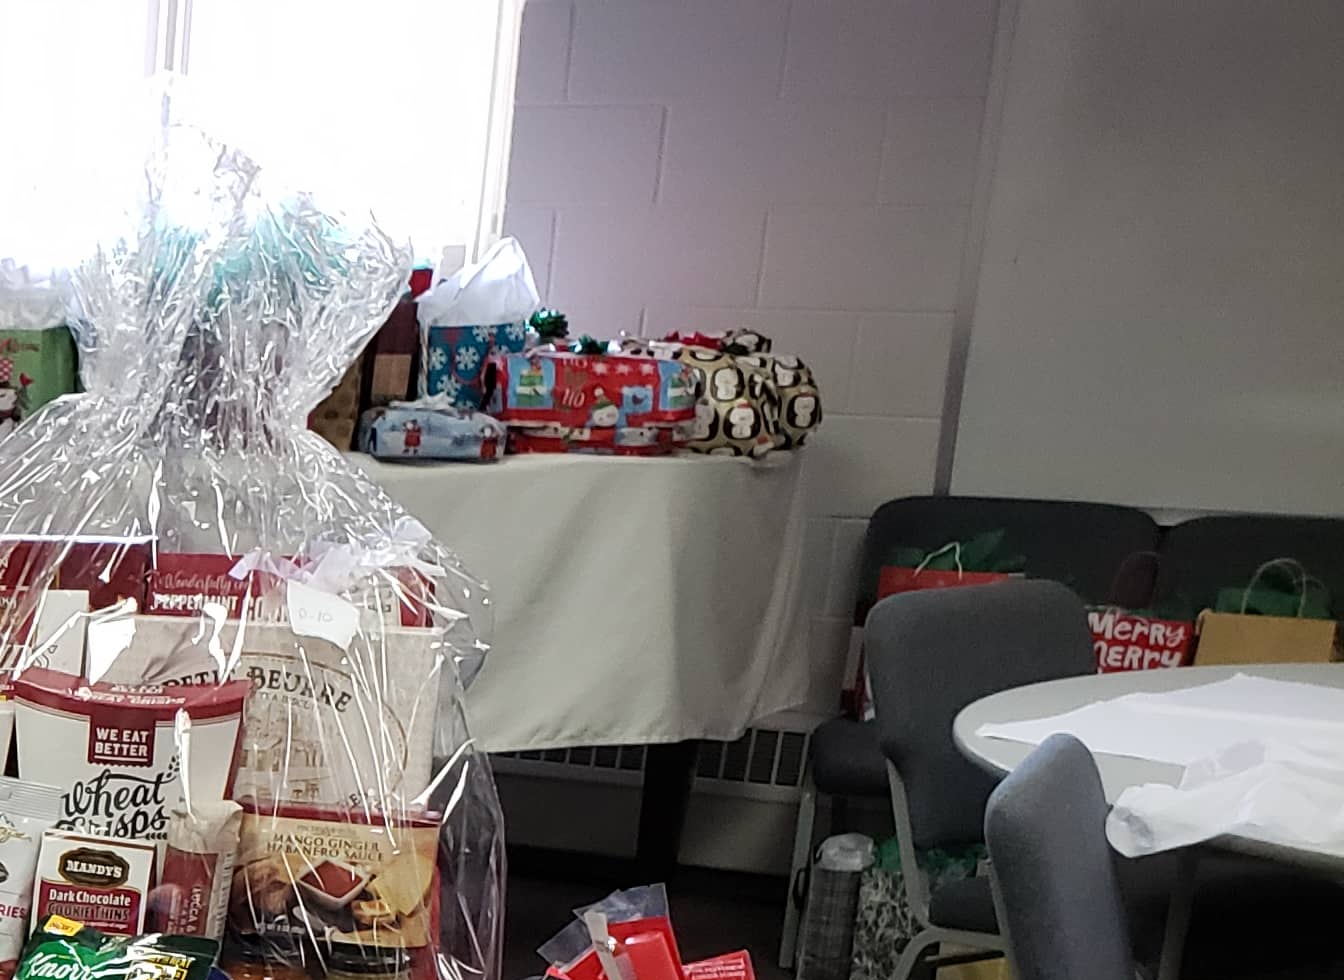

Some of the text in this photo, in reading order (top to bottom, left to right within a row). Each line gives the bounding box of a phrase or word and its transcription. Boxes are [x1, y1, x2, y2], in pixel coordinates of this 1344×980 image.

[95, 727, 150, 744] WE EAT
[95, 742, 149, 758] BETTER
[342, 848, 385, 862] SAUCE
[66, 859, 124, 880] MANDY'S
[49, 888, 132, 908] Dark Chocolate
